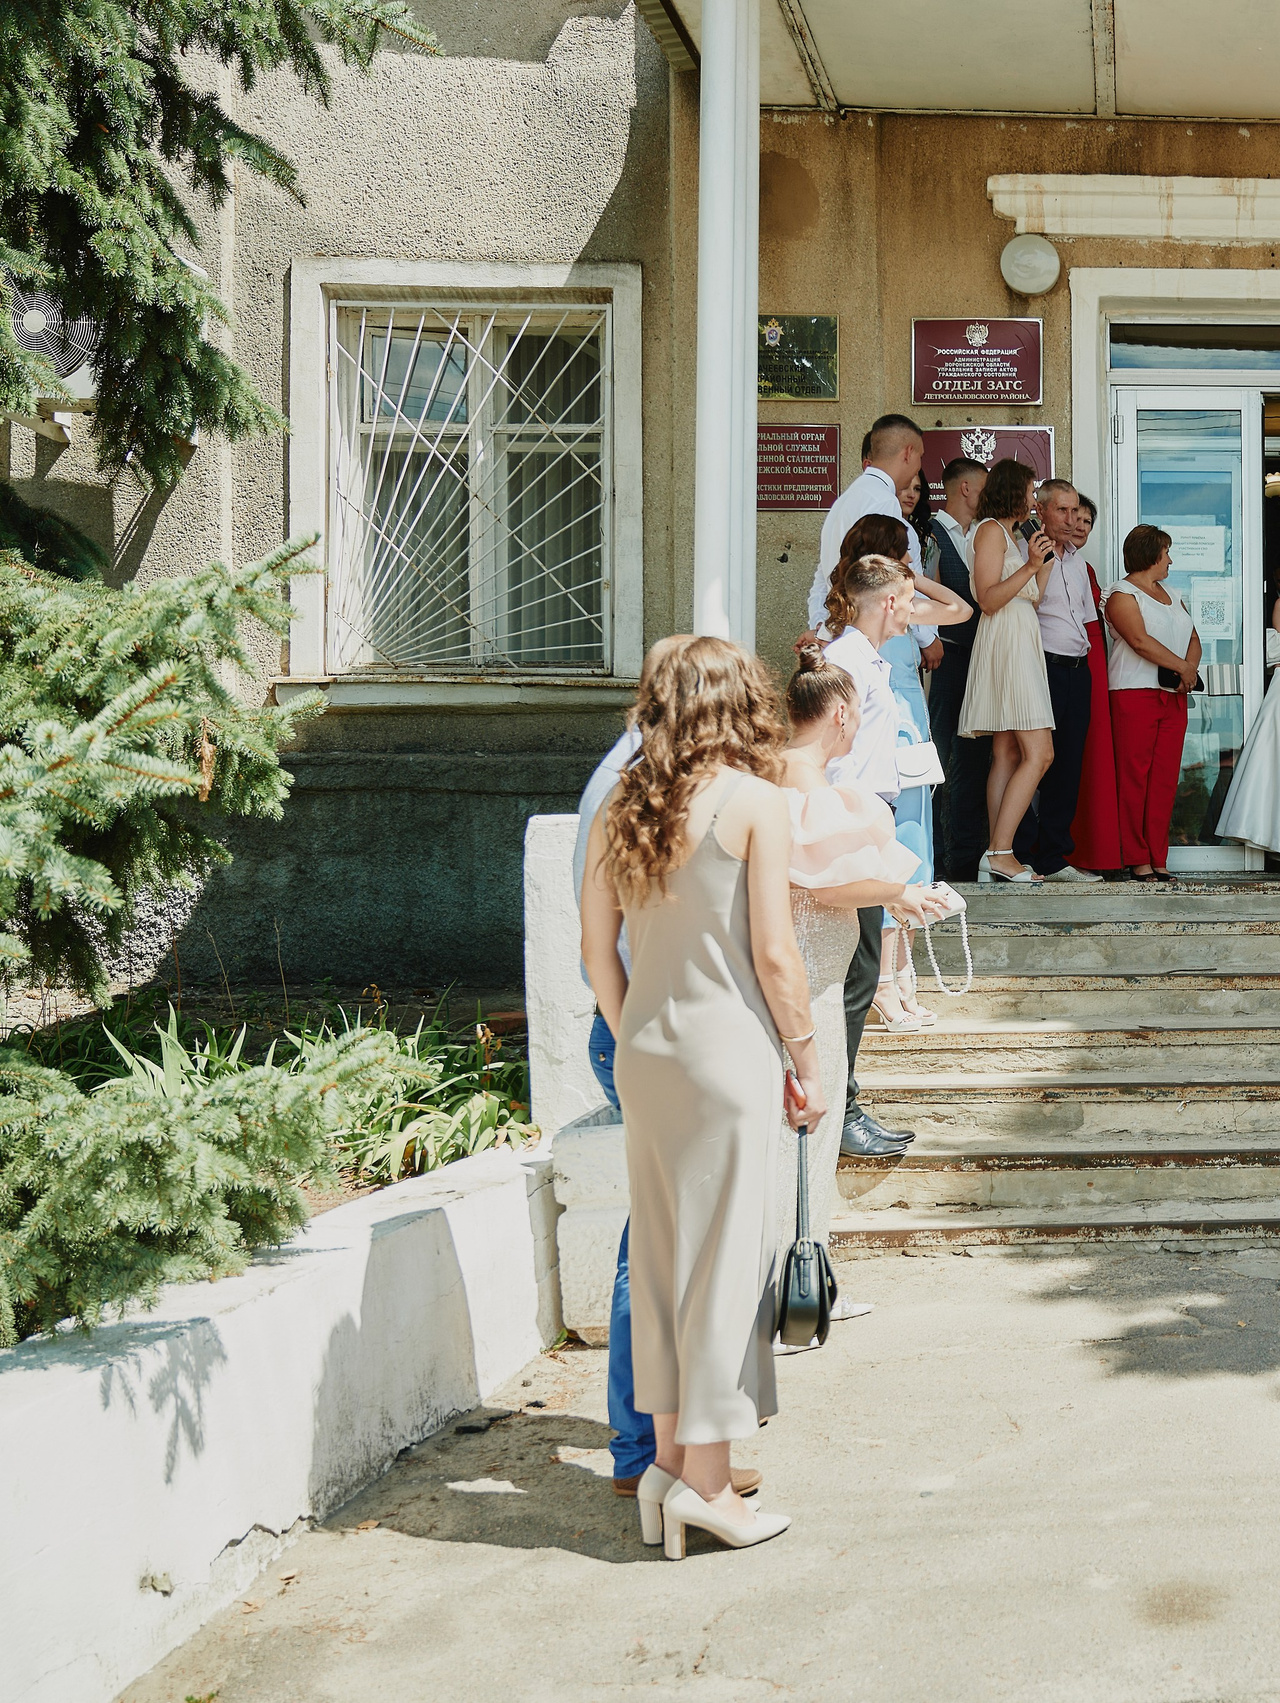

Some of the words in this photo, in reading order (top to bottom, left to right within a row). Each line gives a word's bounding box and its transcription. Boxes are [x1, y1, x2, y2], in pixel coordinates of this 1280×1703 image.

[795, 385, 822, 395] ОТДЕЛ
[932, 381, 982, 392] ОТДЕЛ
[987, 381, 1023, 391] ЗАГС
[801, 433, 825, 441] ОРГАН
[757, 443, 784, 451] ЛЬНОЙ
[786, 444, 820, 452] СЛУЖБЫ
[757, 454, 785, 462] ЕННОЙ
[786, 455, 836, 463] СТАТИСТИКИ
[757, 465, 791, 474] ЕЖСКОЙ
[793, 466, 828, 474] ОБЛАСТИ
[783, 483, 832, 492] ПРЕДПРИЯТИЙ
[796, 493, 822, 502] РАЙОН)
